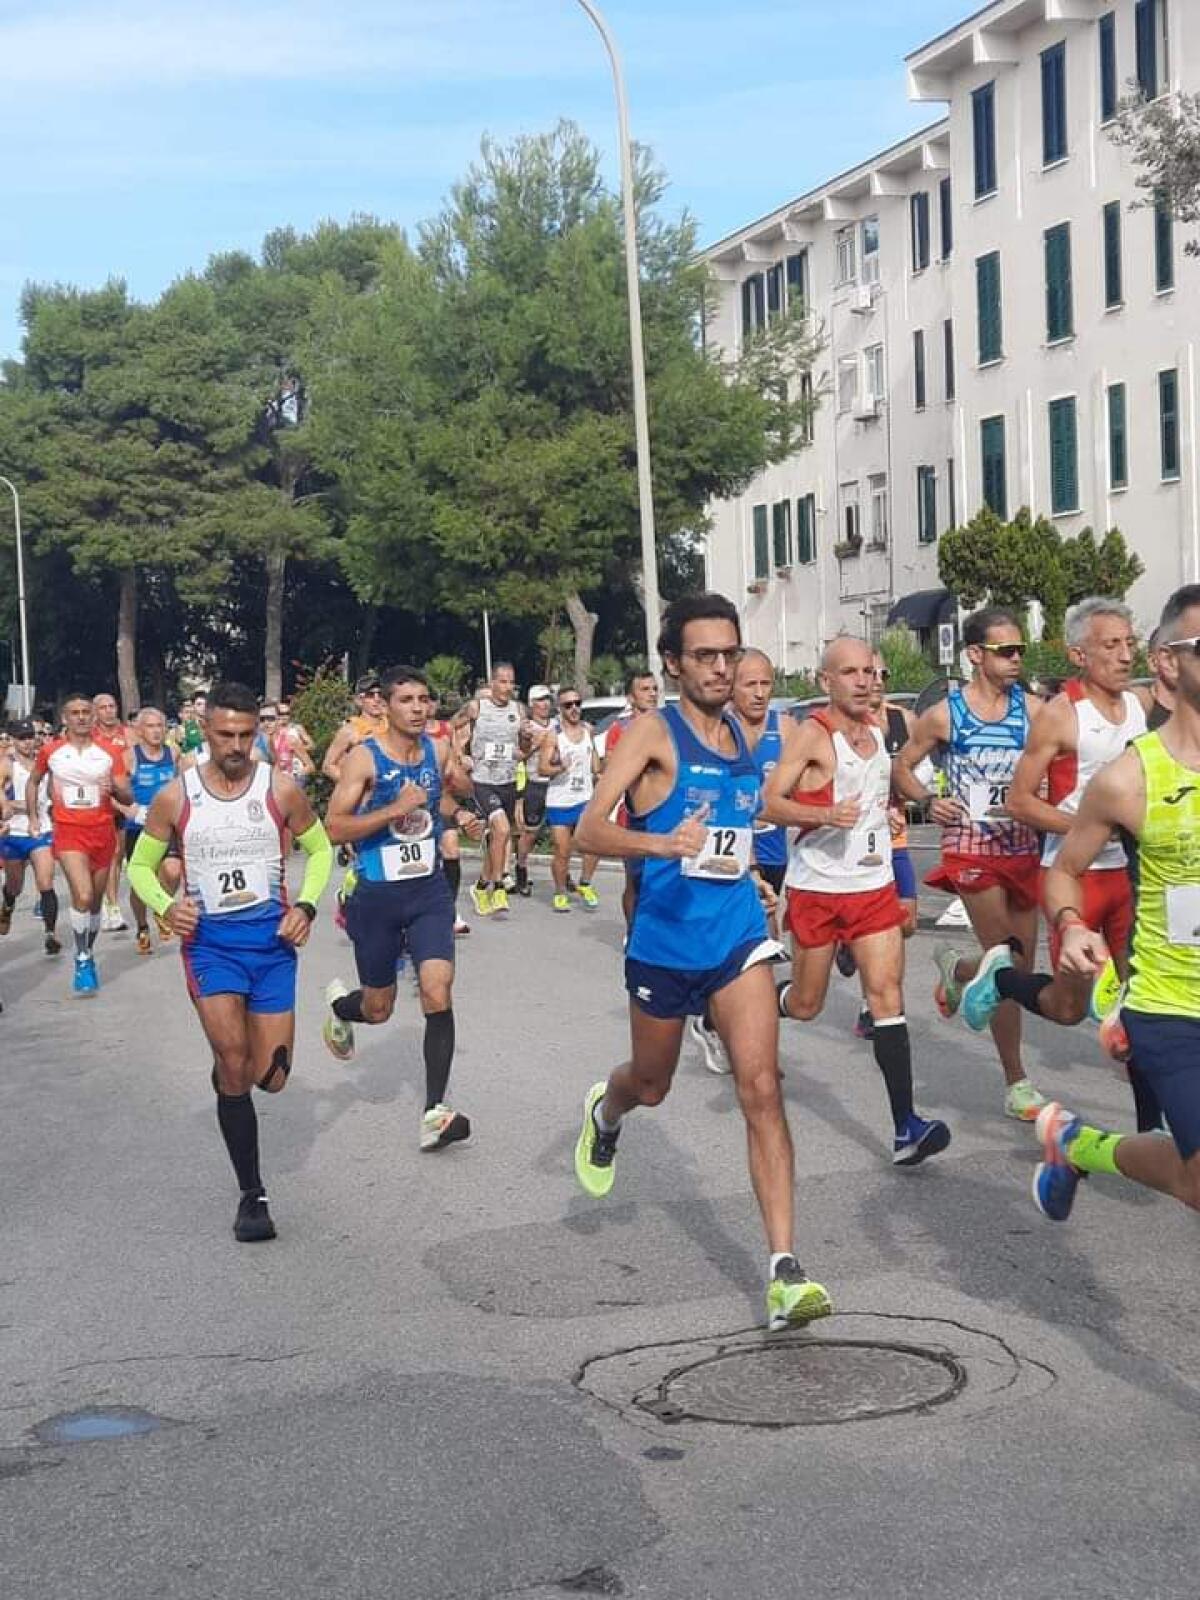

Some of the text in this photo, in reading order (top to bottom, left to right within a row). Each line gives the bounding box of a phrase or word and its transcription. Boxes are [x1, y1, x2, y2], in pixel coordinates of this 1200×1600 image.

[399, 843, 422, 863] 30
[712, 829, 736, 856] 12
[867, 832, 876, 854] 9
[218, 868, 247, 894] 28
